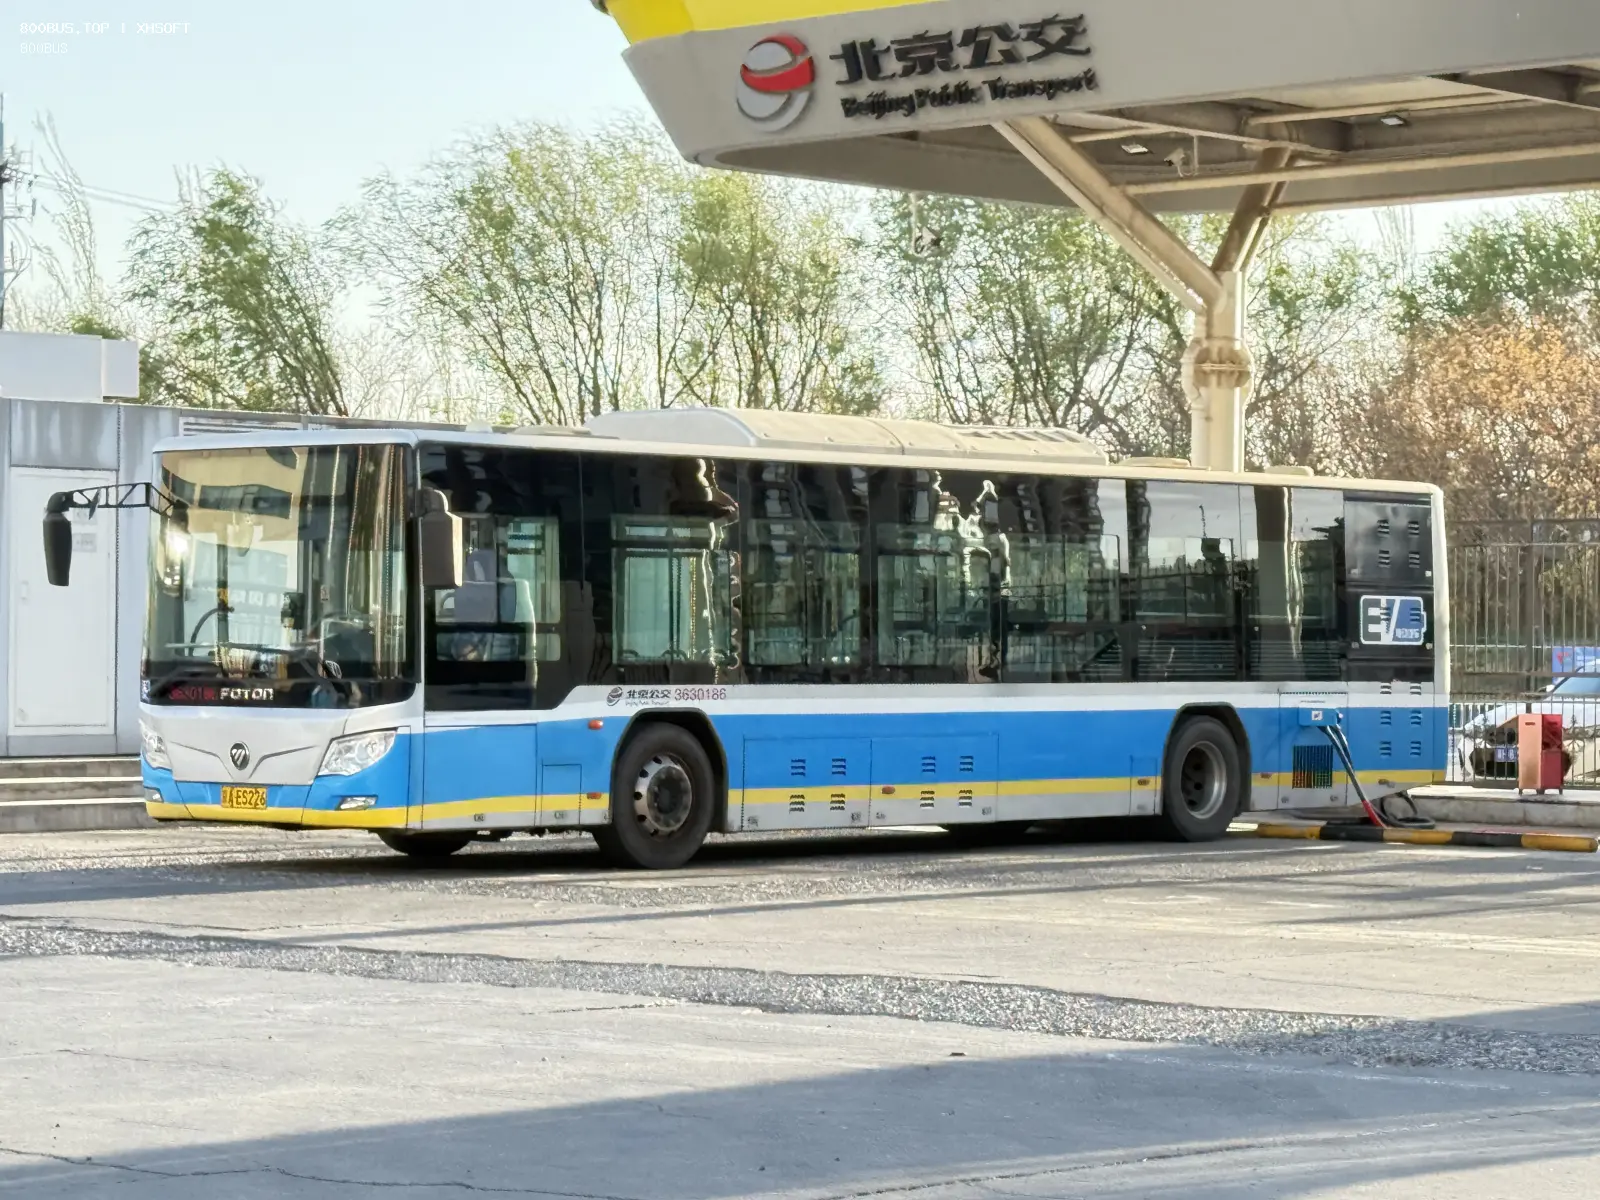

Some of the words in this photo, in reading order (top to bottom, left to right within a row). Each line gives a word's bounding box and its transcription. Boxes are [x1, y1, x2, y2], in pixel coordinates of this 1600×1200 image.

[829, 13, 1093, 86] 北京公交
[841, 90, 915, 119] Beijing
[914, 80, 983, 109] Public
[982, 67, 1098, 101] Transport
[674, 687, 727, 701] 3630186
